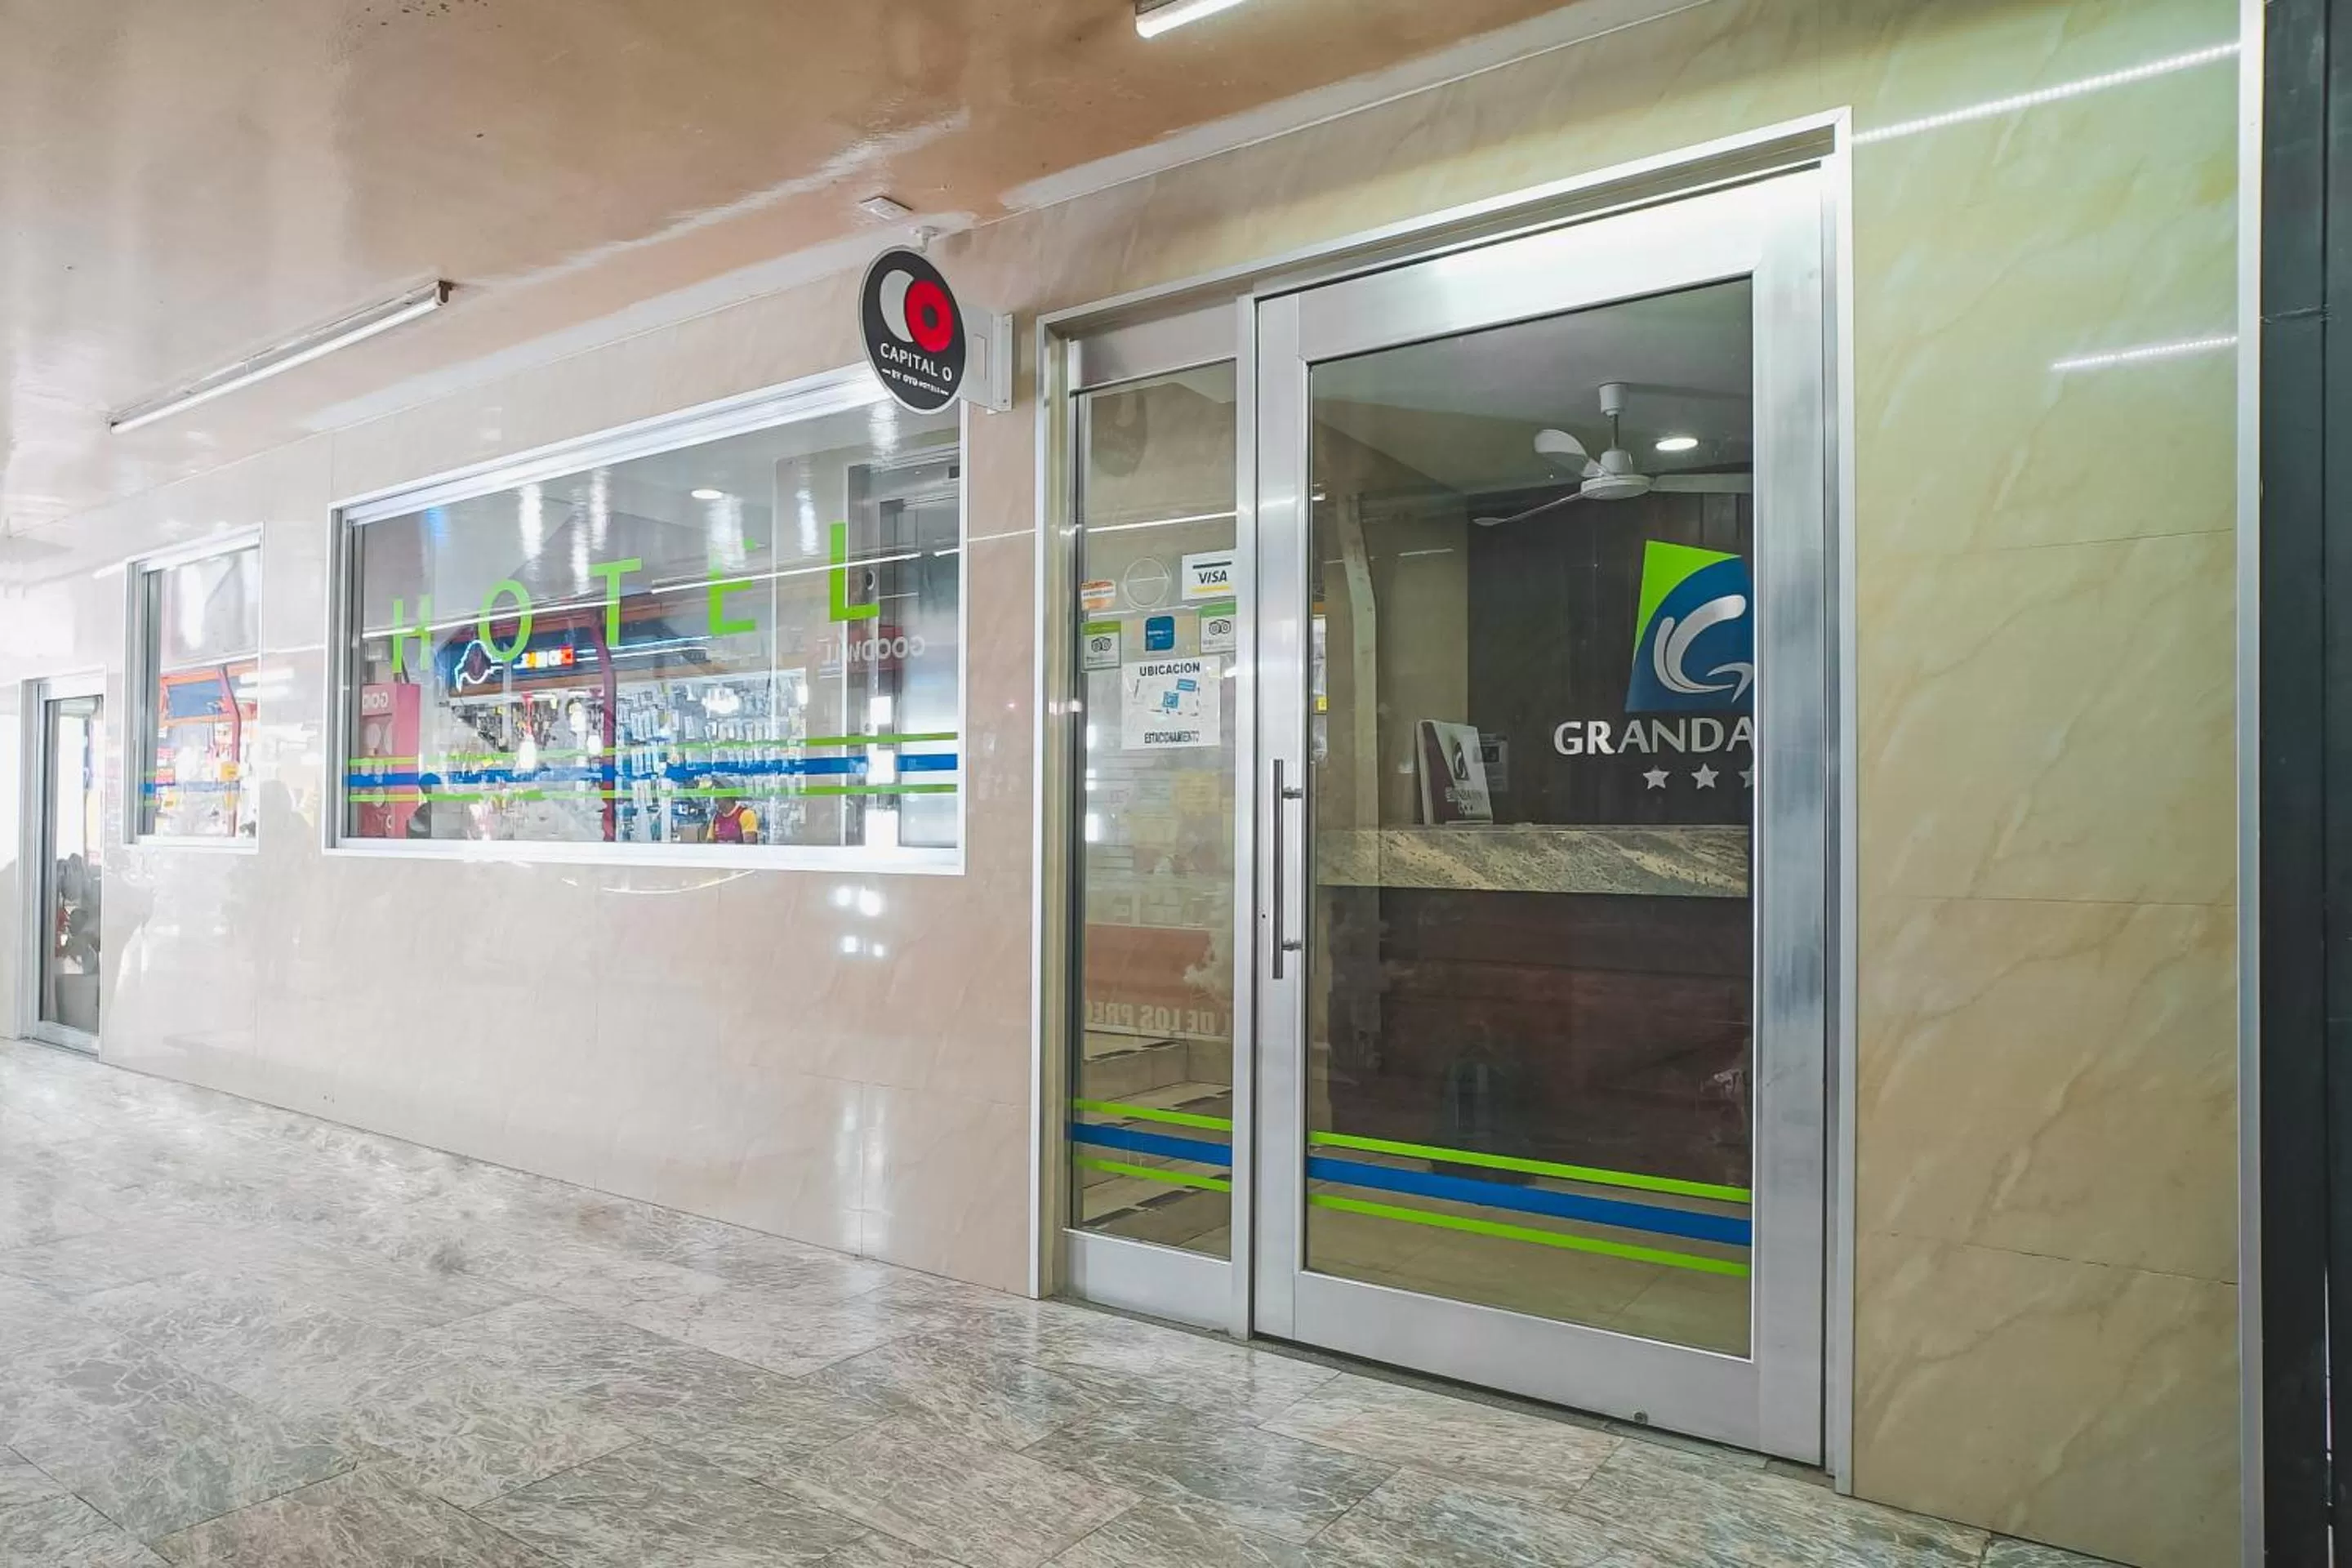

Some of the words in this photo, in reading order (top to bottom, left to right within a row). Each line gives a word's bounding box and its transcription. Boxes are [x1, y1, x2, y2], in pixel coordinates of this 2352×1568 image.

[880, 342, 938, 377] CAPITAL
[942, 366, 952, 382] O
[1197, 570, 1227, 584] VISA
[391, 522, 880, 674] HOTEL
[1139, 662, 1200, 676] UBICACION
[1553, 715, 1754, 755] GRANDA
